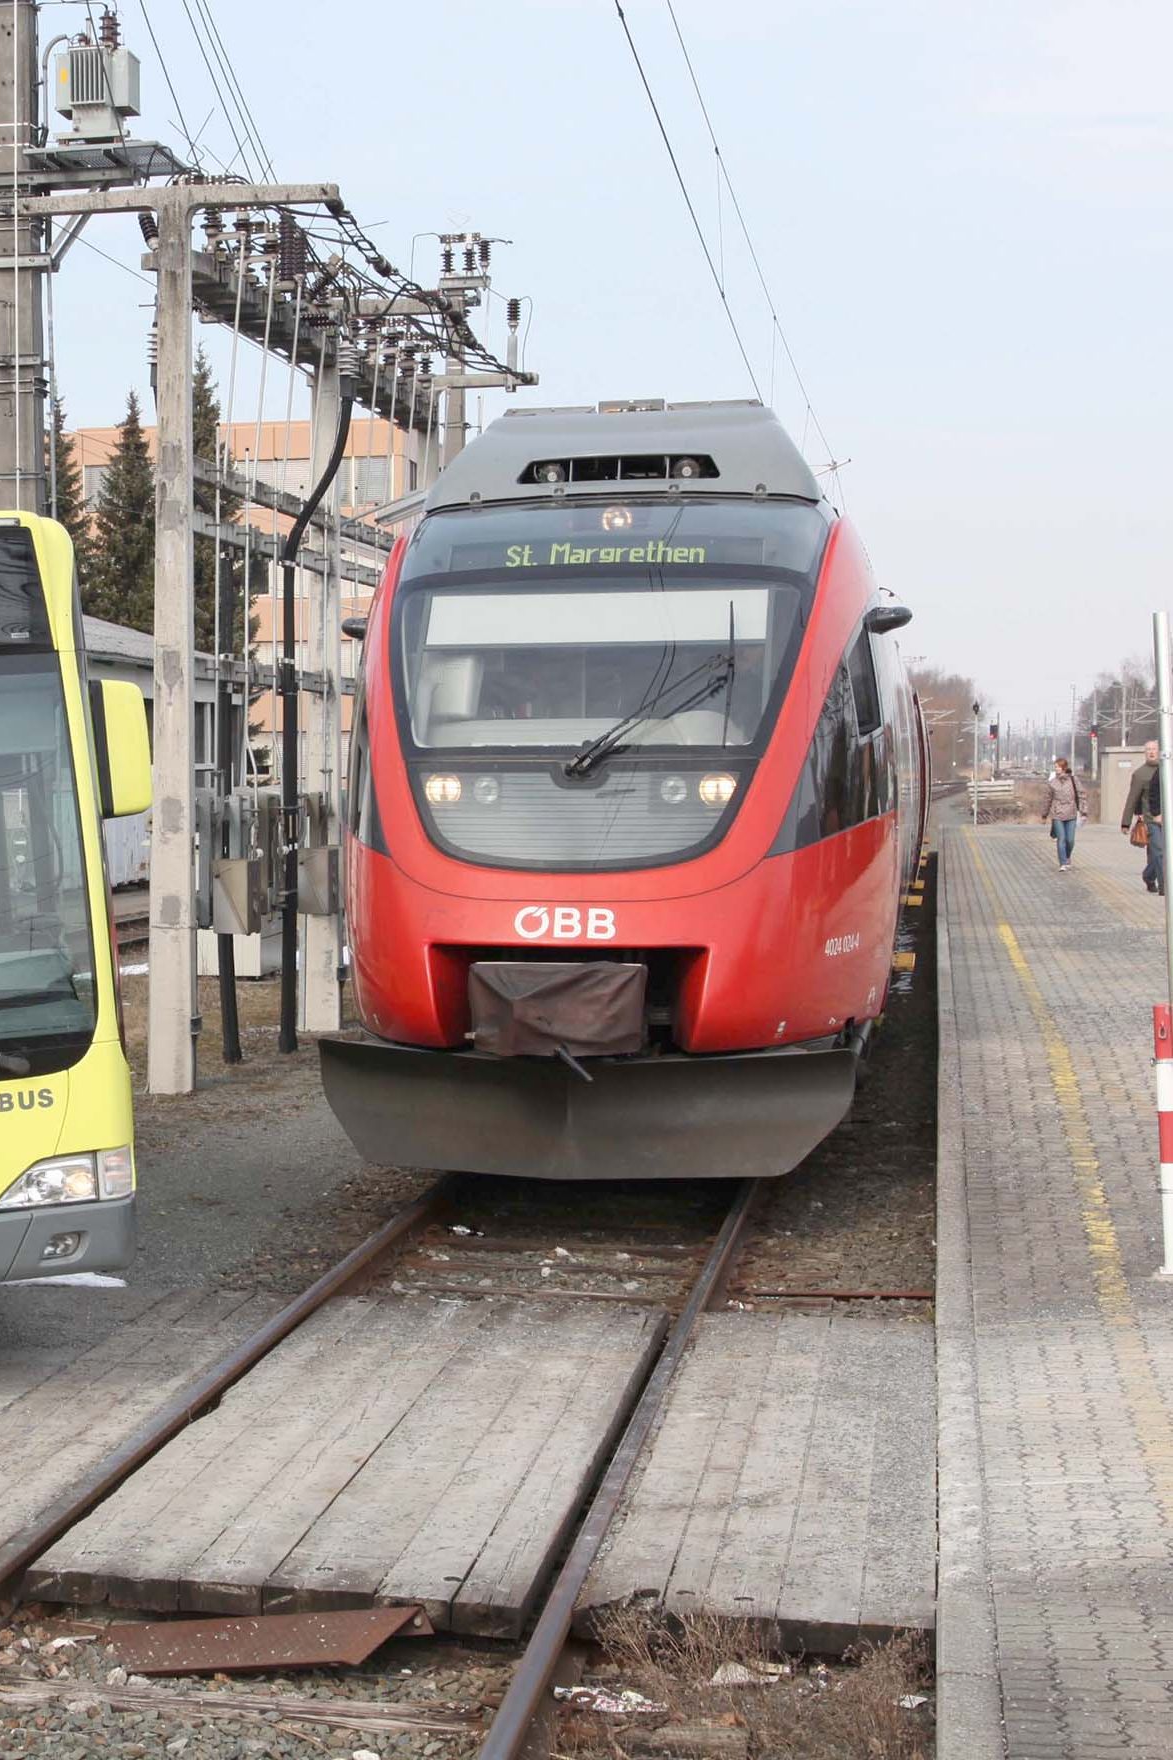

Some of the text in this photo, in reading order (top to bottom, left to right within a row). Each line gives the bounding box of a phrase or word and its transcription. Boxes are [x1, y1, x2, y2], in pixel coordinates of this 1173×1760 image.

[505, 540, 706, 567] St. Margrethen
[514, 906, 616, 940] ÖBB
[824, 937, 843, 956] 4024
